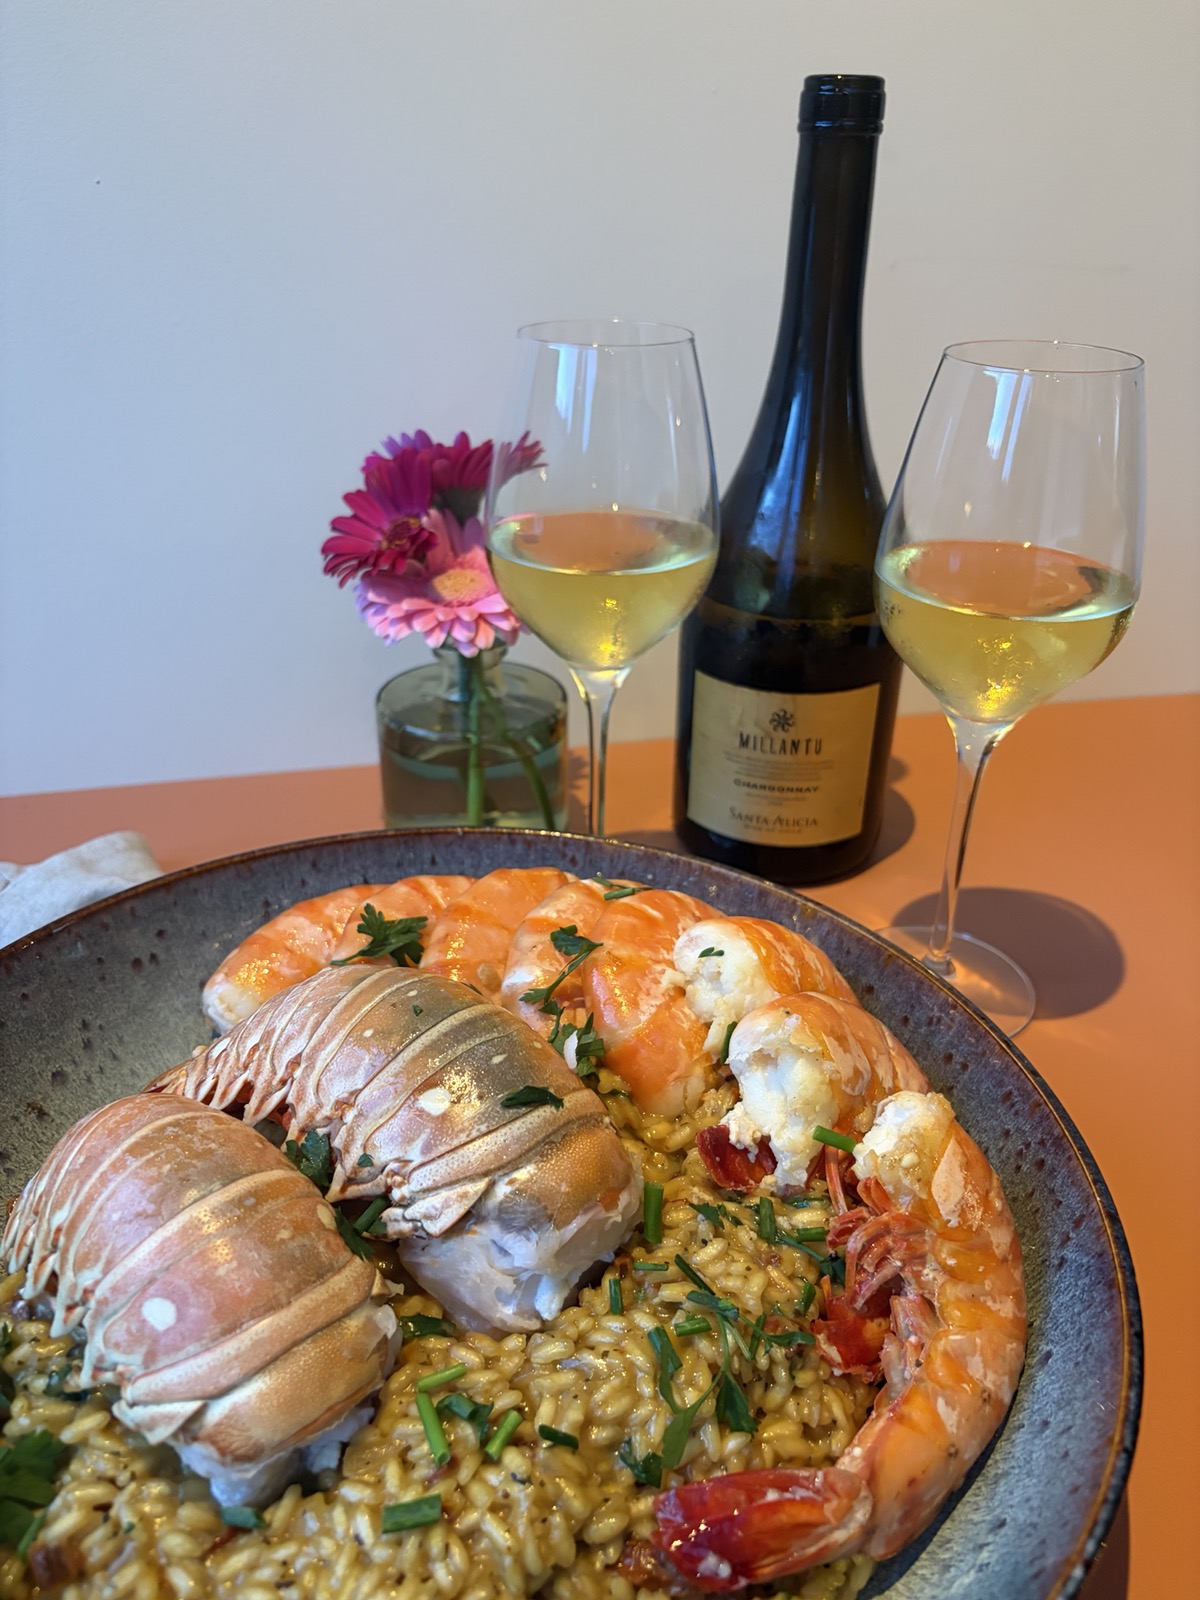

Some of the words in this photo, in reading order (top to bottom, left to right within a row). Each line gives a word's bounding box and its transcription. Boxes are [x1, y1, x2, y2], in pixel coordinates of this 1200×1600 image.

[738, 731, 823, 756] MILLANTU
[733, 777, 820, 794] CHARDONNAY
[728, 806, 769, 826] SANTA
[773, 815, 818, 828] ALICIA
